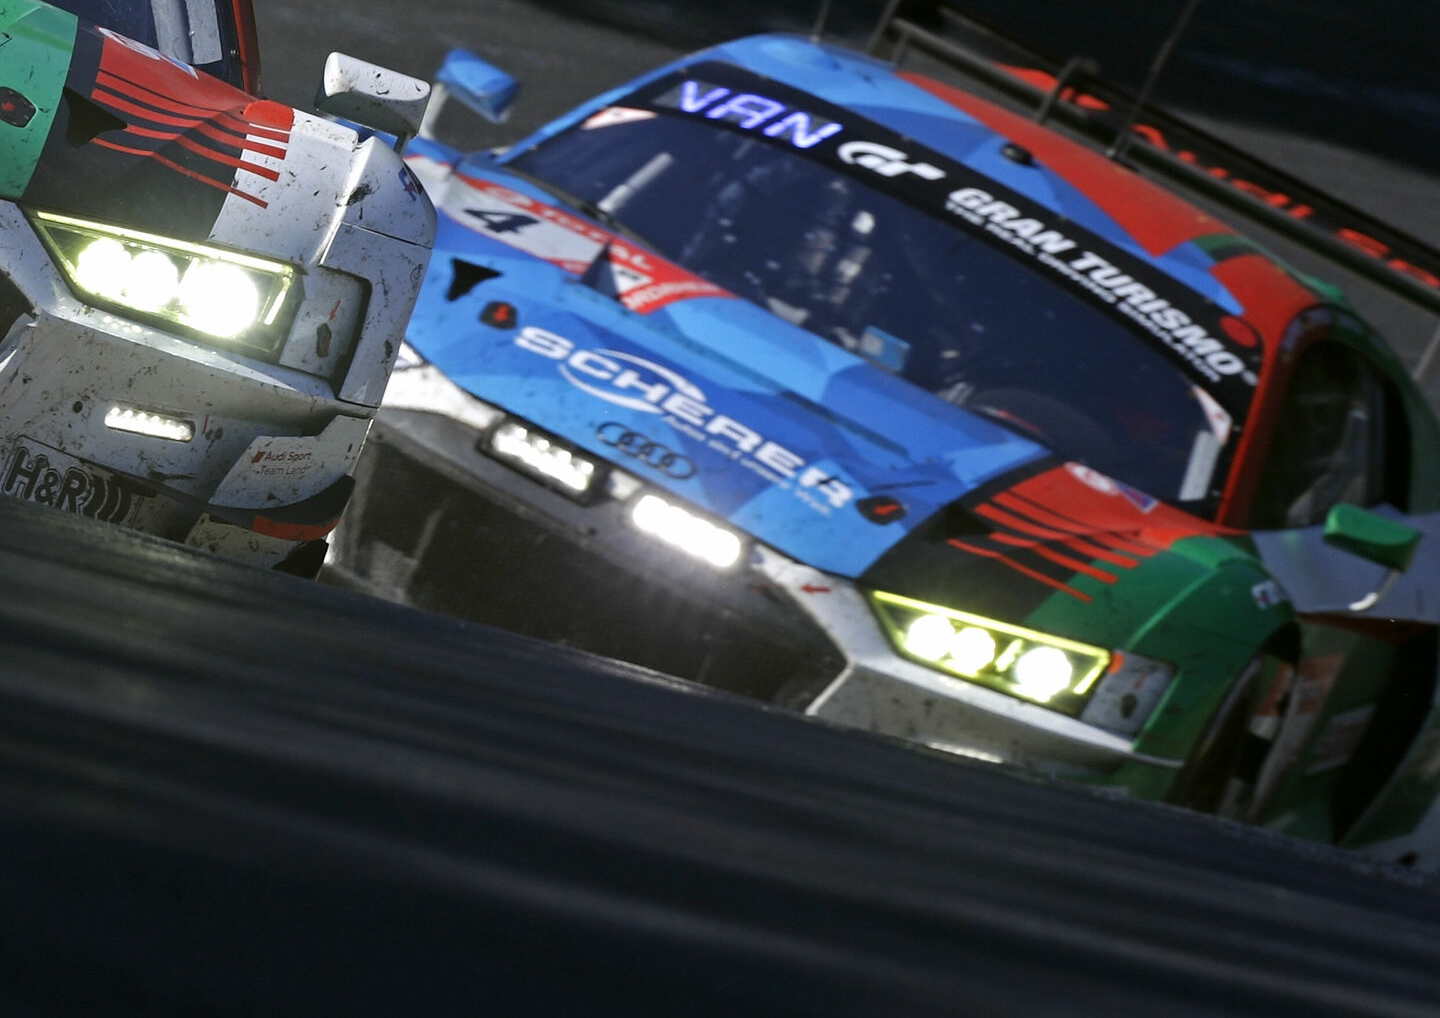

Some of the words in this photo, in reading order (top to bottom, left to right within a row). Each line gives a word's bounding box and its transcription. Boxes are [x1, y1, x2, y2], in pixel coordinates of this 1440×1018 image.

[679, 80, 843, 150] VAN
[465, 208, 540, 237] 4
[947, 186, 1062, 255] GRAN
[1071, 250, 1246, 376] TURISMO
[514, 325, 855, 510] SCHERER
[3, 446, 90, 514] H&R
[261, 465, 284, 476] Team
[264, 450, 286, 461] Audi
[288, 451, 312, 463] Sport
